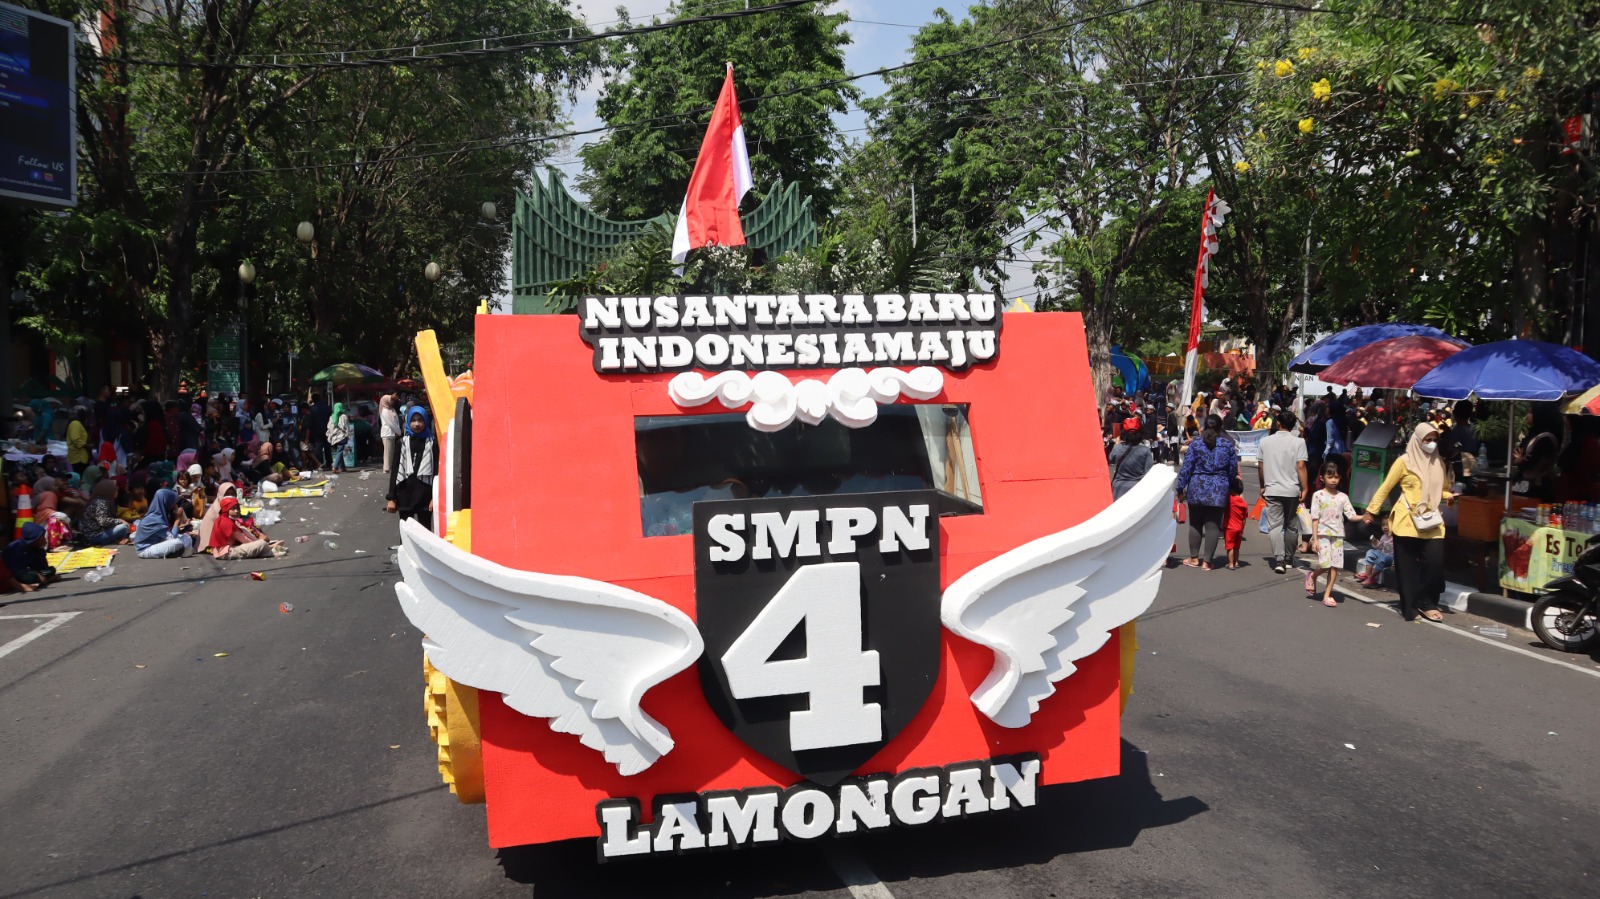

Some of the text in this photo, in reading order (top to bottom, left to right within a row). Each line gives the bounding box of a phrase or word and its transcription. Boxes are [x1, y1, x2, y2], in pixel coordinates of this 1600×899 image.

[18, 155, 49, 169] Follow
[707, 504, 930, 562] SMPN
[1545, 534, 1559, 555] Es
[720, 562, 883, 752] 4
[602, 760, 1040, 857] LAMONGAN
